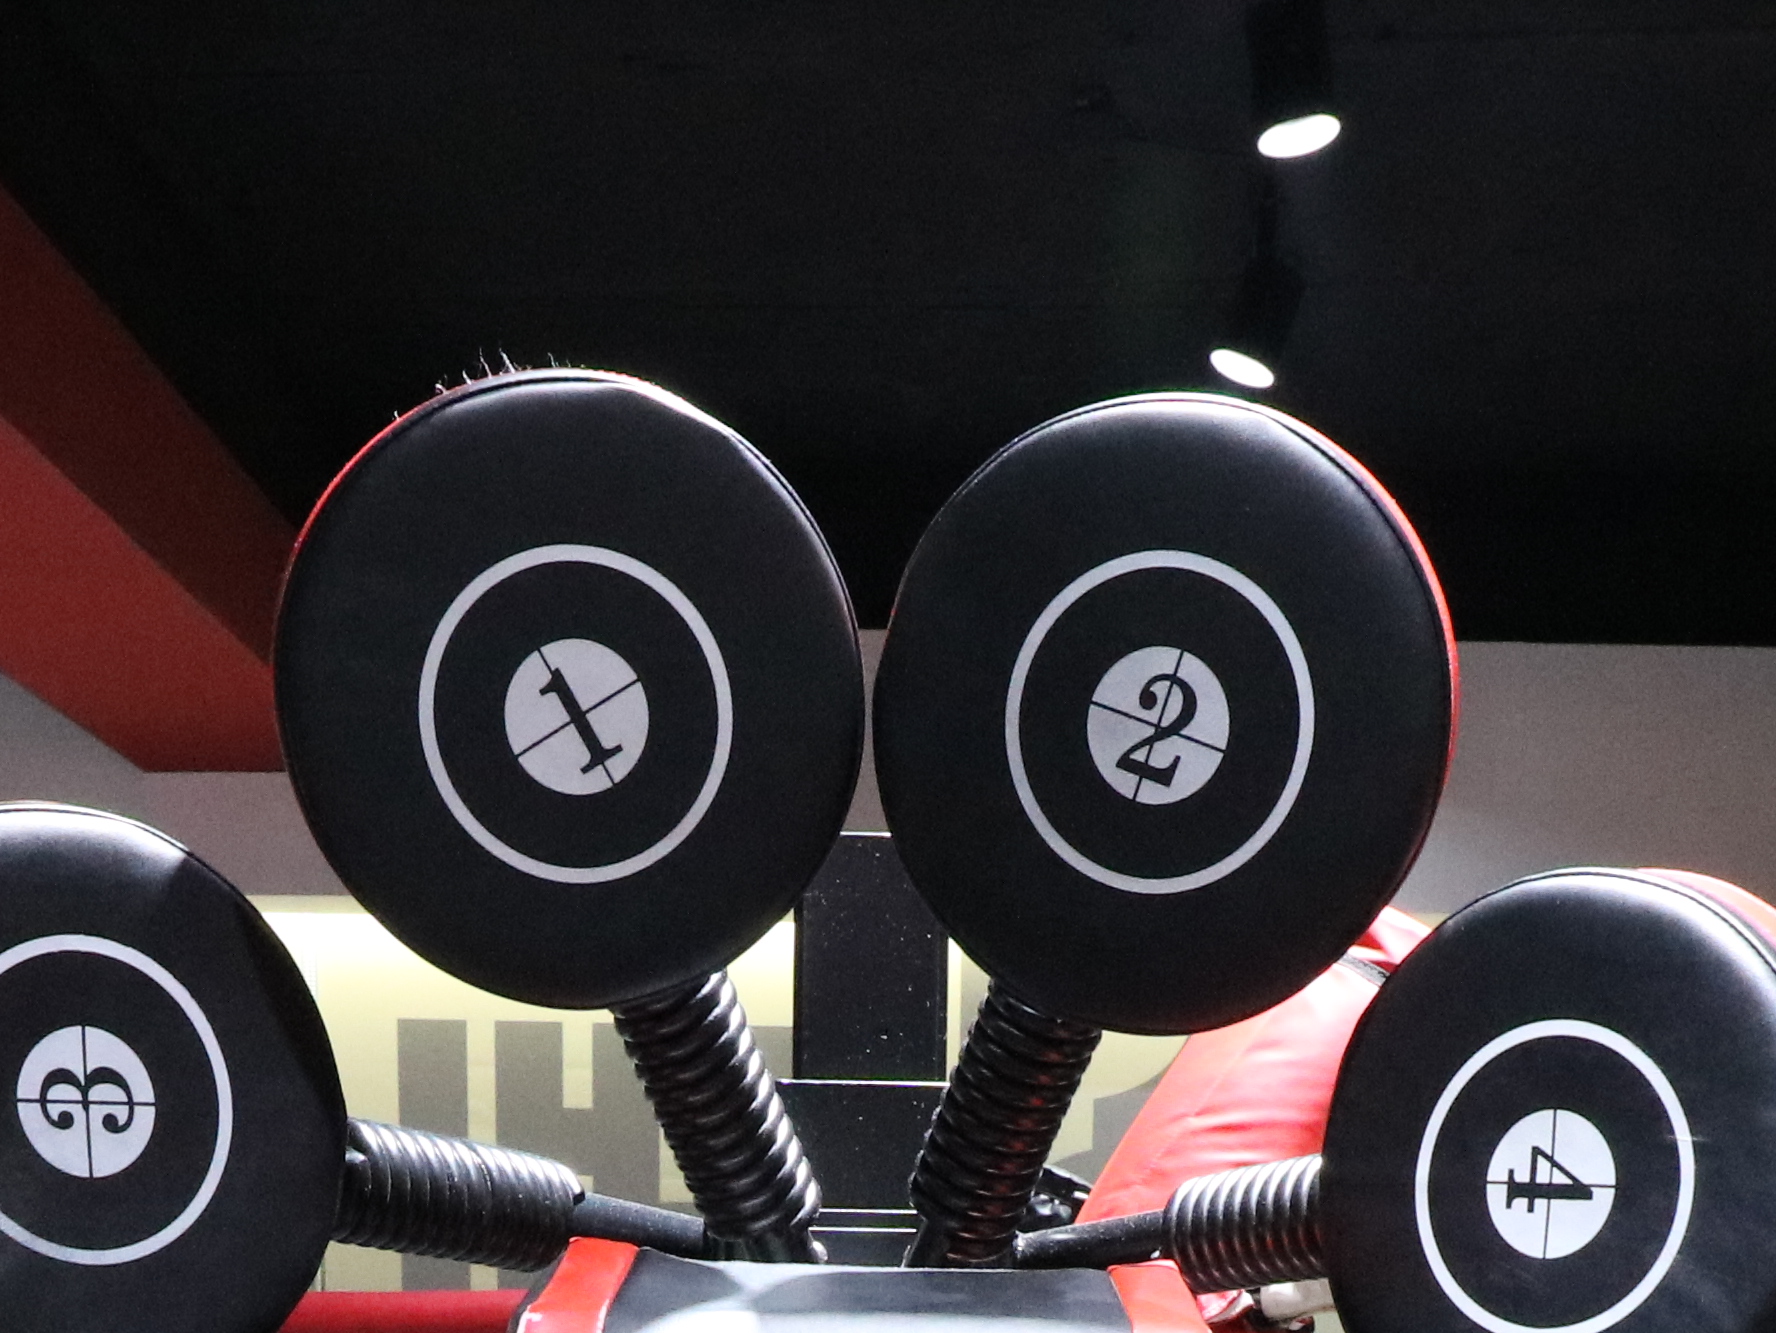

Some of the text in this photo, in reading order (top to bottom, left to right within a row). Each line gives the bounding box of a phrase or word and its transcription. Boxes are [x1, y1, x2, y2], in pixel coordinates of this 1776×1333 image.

[539, 667, 623, 773] 1
[1117, 673, 1197, 786] 2
[39, 1066, 134, 1134] 3
[1506, 1145, 1594, 1213] 4
